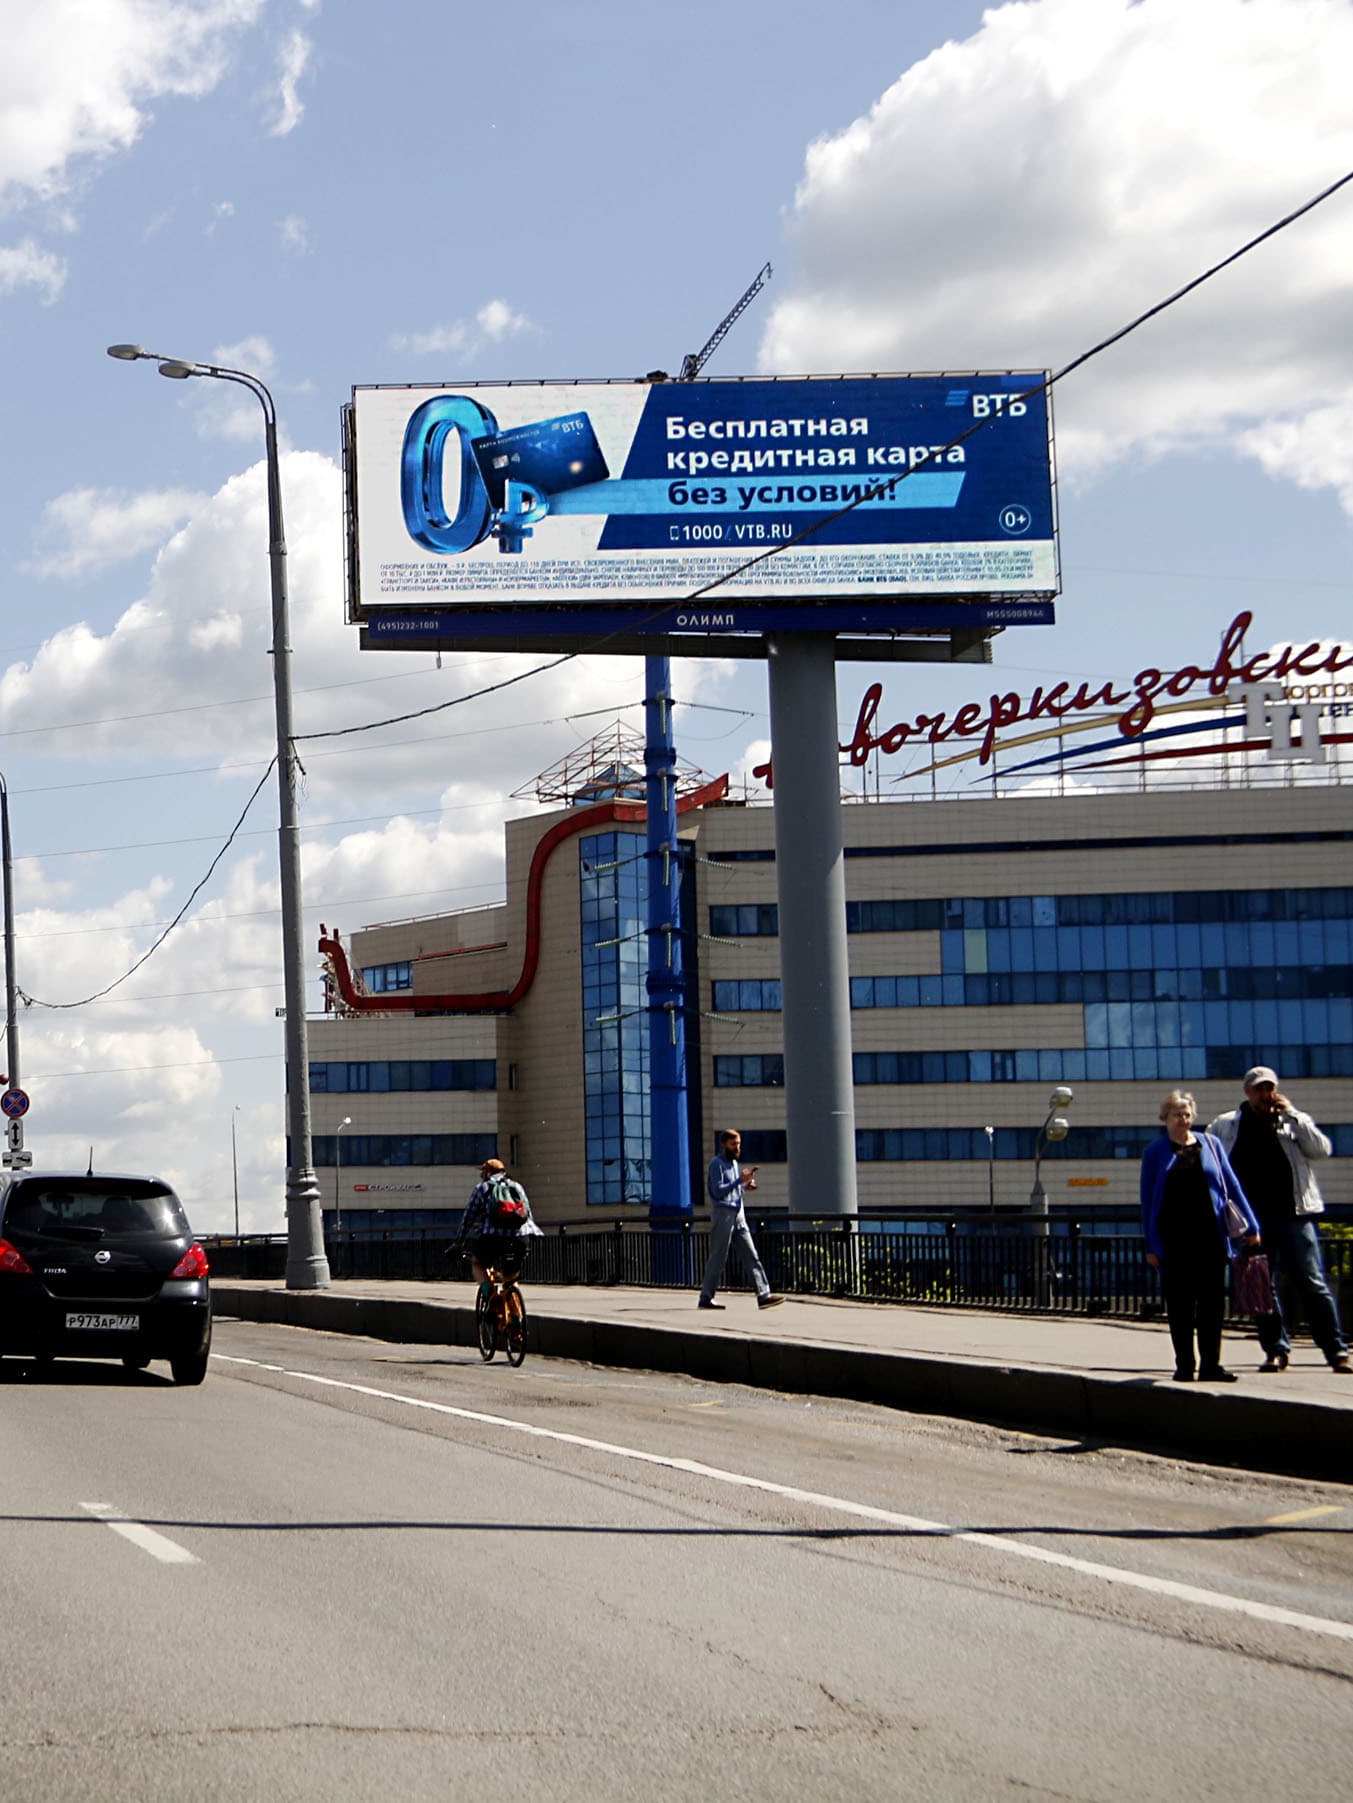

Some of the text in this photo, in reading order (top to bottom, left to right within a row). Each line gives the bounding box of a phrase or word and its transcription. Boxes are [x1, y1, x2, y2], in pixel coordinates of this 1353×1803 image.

[972, 393, 1027, 418] ВТБ
[666, 416, 868, 440] Бесплатная
[667, 444, 966, 475] кредитная карта
[668, 477, 897, 510] без условий!
[1005, 511, 1027, 527] 0+
[682, 524, 723, 540] 1000
[735, 523, 792, 539] VTB.RU
[676, 613, 734, 626] ОЛИМП
